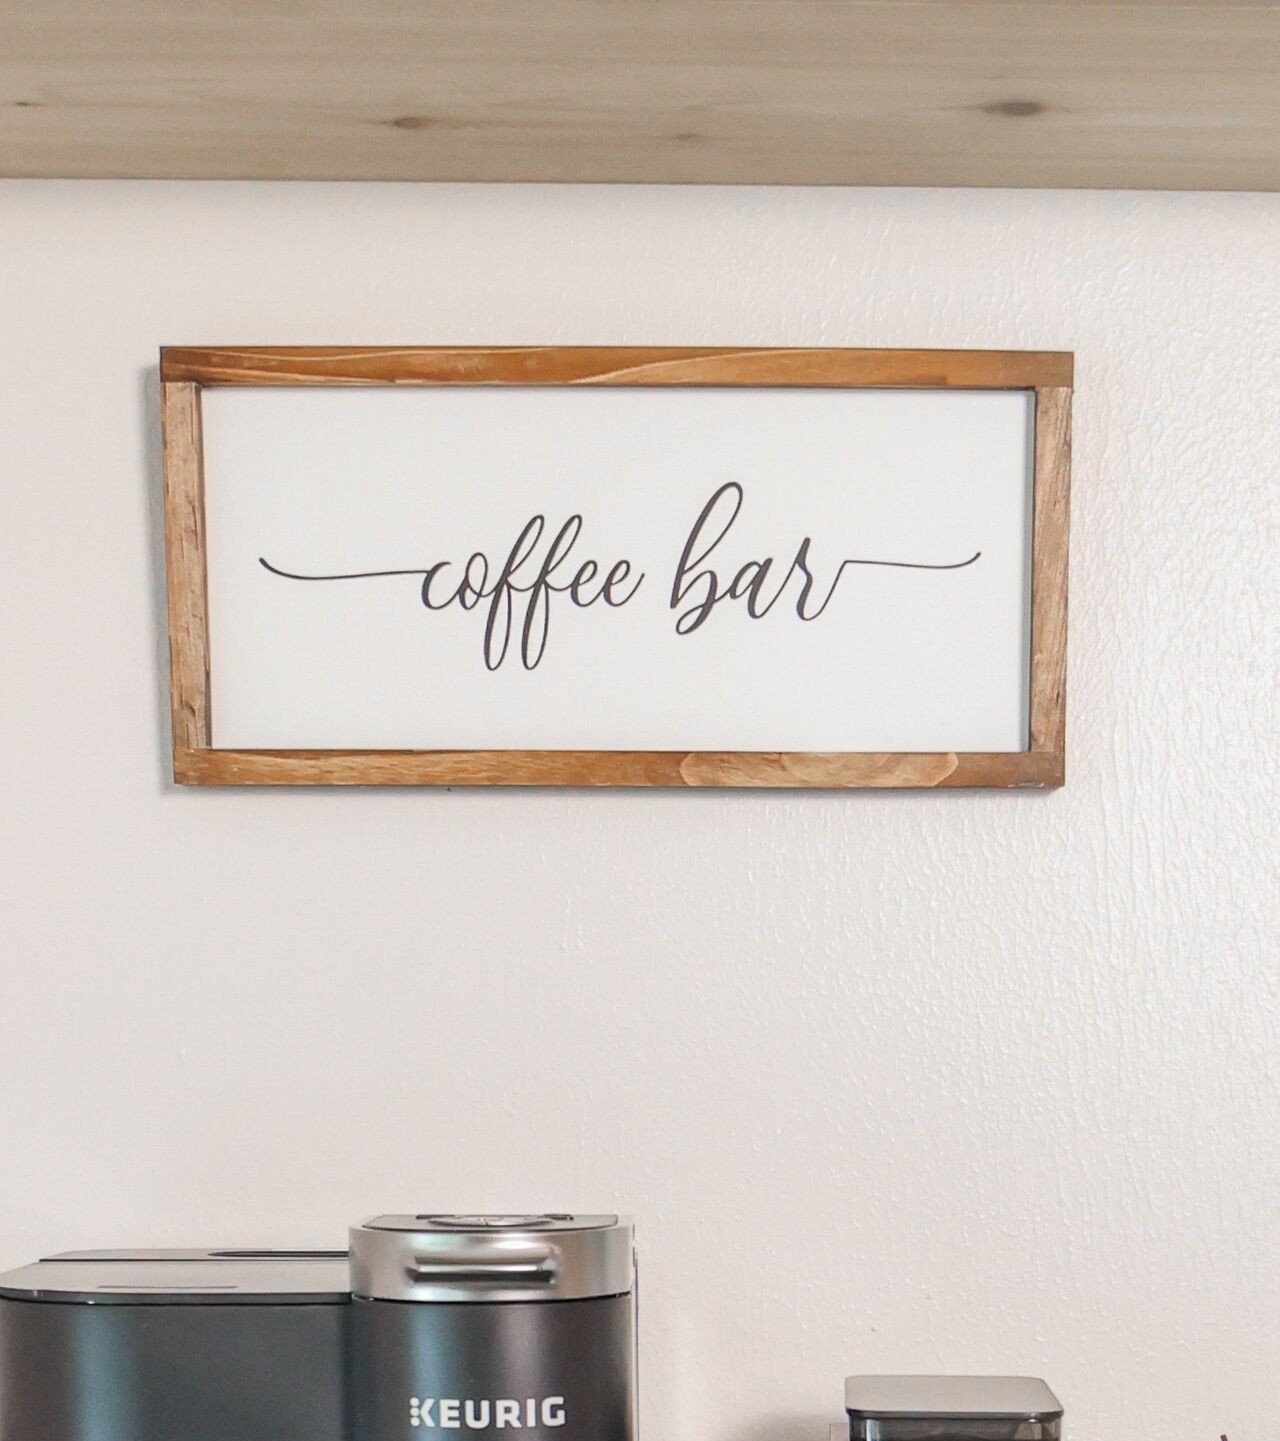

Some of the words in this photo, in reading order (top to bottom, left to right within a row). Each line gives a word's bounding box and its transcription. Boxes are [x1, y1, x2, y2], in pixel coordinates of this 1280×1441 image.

[420, 513, 646, 671] coffee
[670, 481, 848, 636] bar
[409, 1396, 567, 1430] KEURIG
